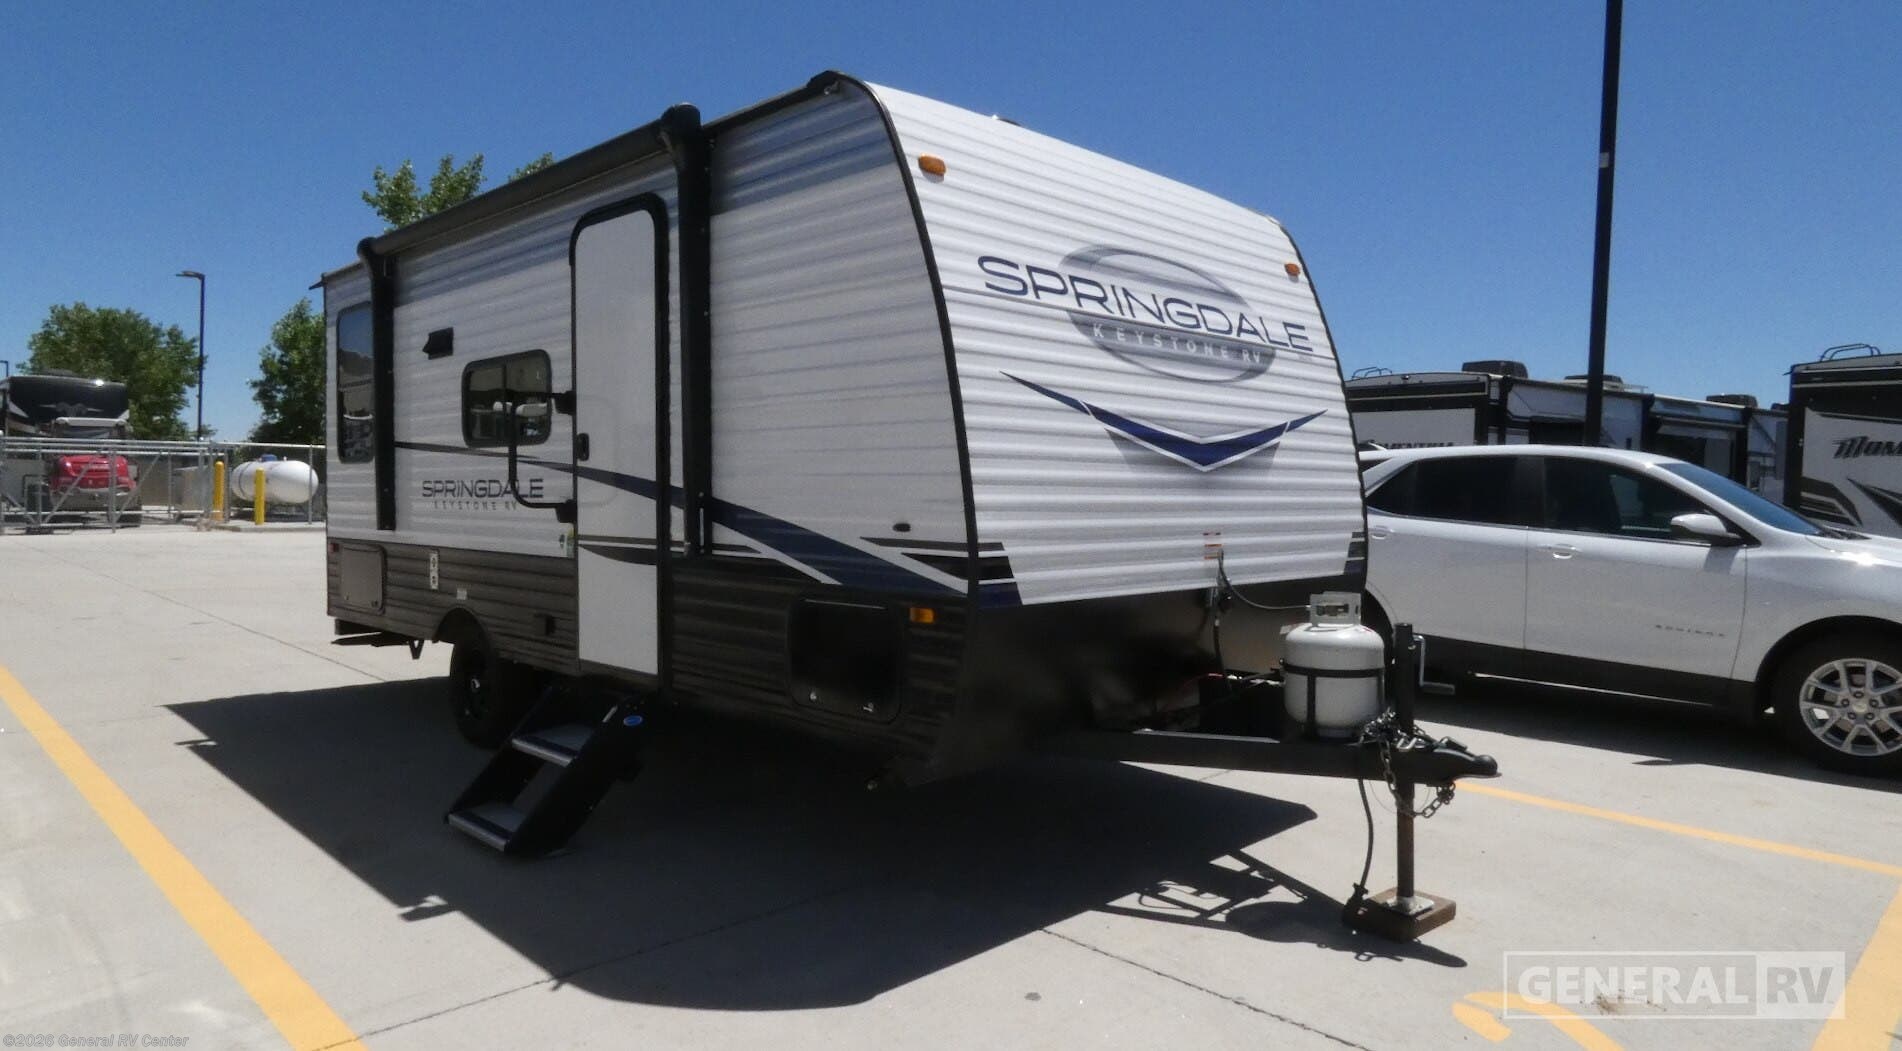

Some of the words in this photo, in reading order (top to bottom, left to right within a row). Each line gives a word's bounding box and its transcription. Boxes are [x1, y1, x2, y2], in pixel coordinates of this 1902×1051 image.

[978, 255, 1313, 352] SPRINGDALE
[1093, 322, 1230, 360] KEYSTONE
[1241, 347, 1262, 364] RV
